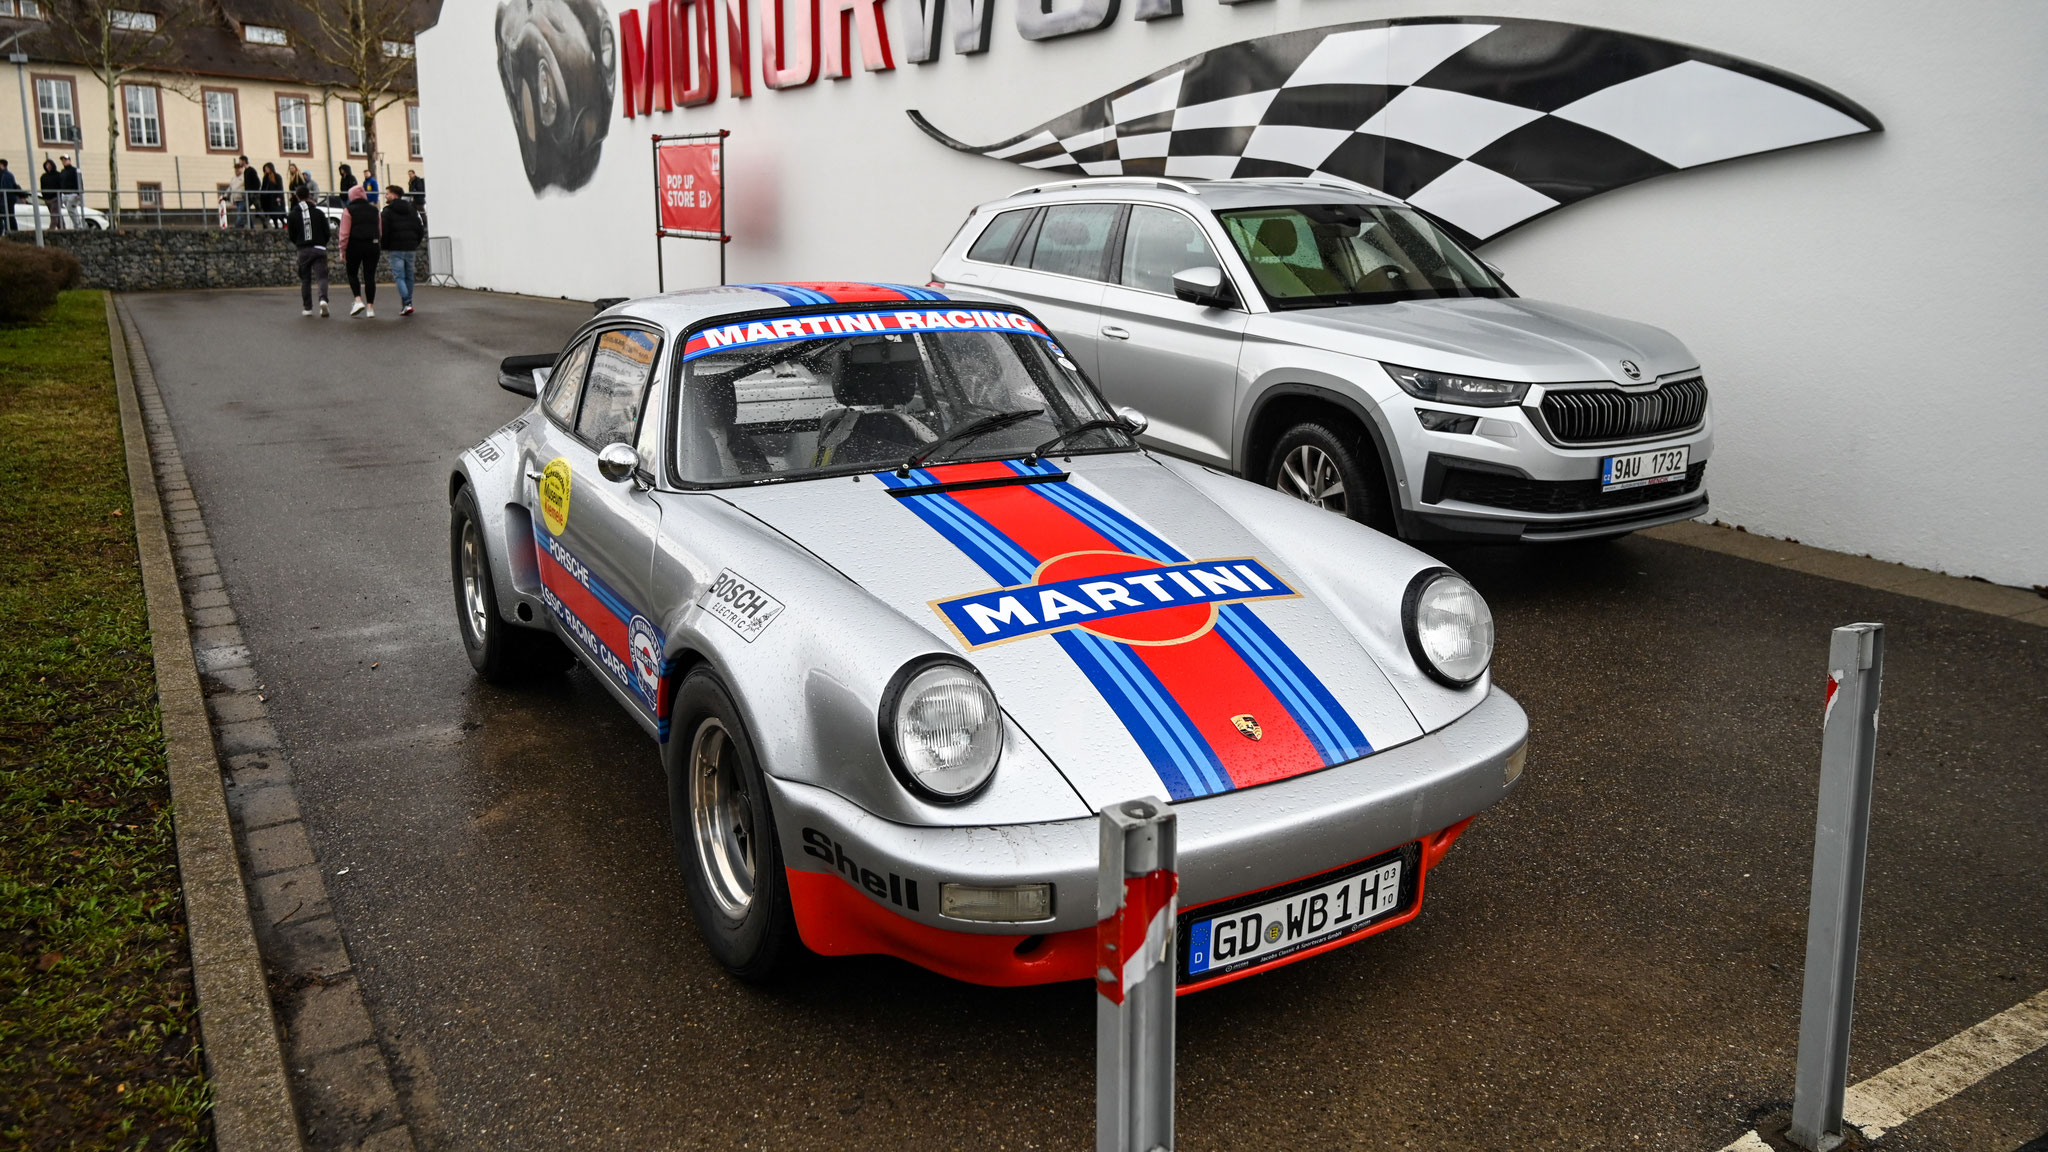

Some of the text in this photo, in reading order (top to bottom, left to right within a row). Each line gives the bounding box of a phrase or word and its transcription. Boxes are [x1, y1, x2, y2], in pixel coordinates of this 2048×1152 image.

[667, 174, 695, 190] POP UP
[667, 190, 695, 208] STORE
[702, 310, 1036, 349] MARTINI RACING
[1603, 474, 1611, 482] CZ
[1614, 450, 1683, 480] 9AU 1732
[549, 536, 591, 589] PORSCHE
[708, 572, 769, 619] BOSCH
[961, 564, 1274, 635] MARTINI
[712, 602, 746, 629] ELECTRIC
[564, 607, 599, 655] RACING
[600, 643, 629, 686] CARS
[801, 826, 920, 912] Shell
[1382, 867, 1397, 881] 03
[1381, 892, 1394, 907] 10
[1212, 912, 1263, 962] GD
[1194, 951, 1203, 964] D
